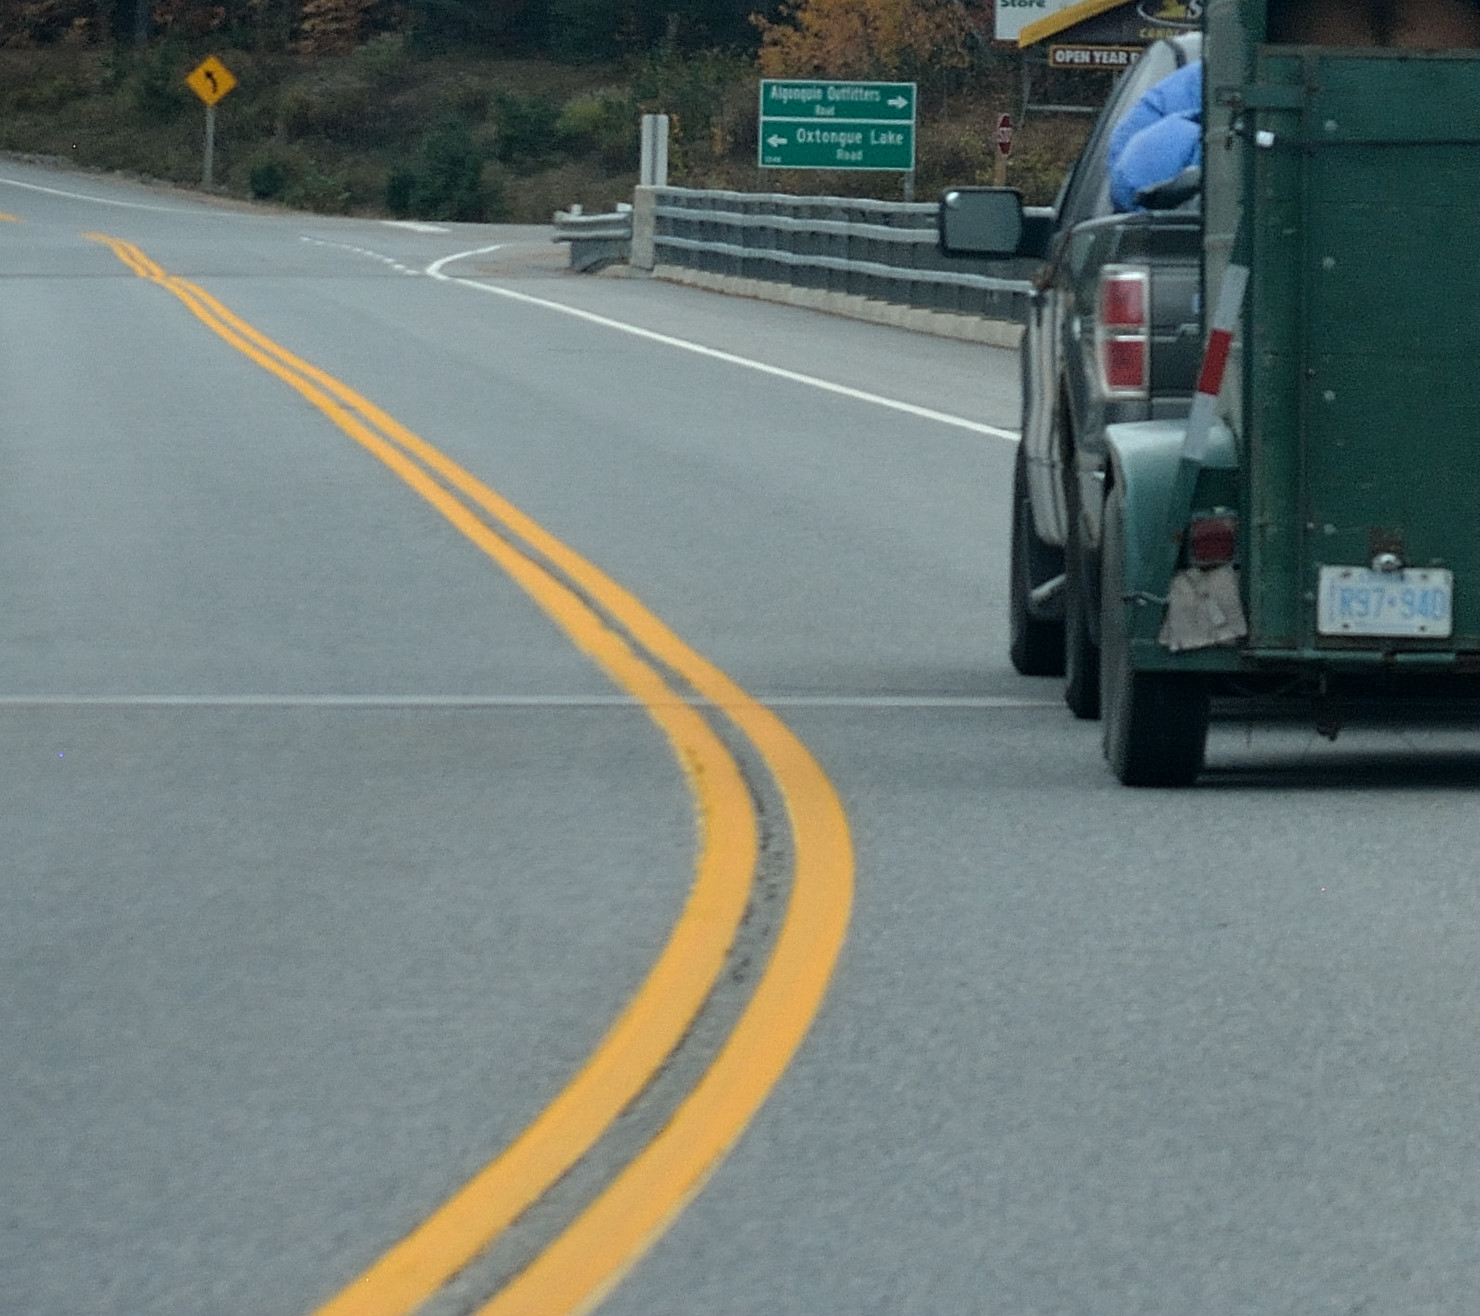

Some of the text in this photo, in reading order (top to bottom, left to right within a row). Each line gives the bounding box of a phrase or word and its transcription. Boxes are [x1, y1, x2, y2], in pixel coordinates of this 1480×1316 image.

[1055, 49, 1091, 63] OPEN
[1092, 50, 1129, 65] YEAR
[770, 85, 823, 104] Algonquin
[796, 127, 904, 148] Oxtongue Lake
[836, 148, 864, 161] Road
